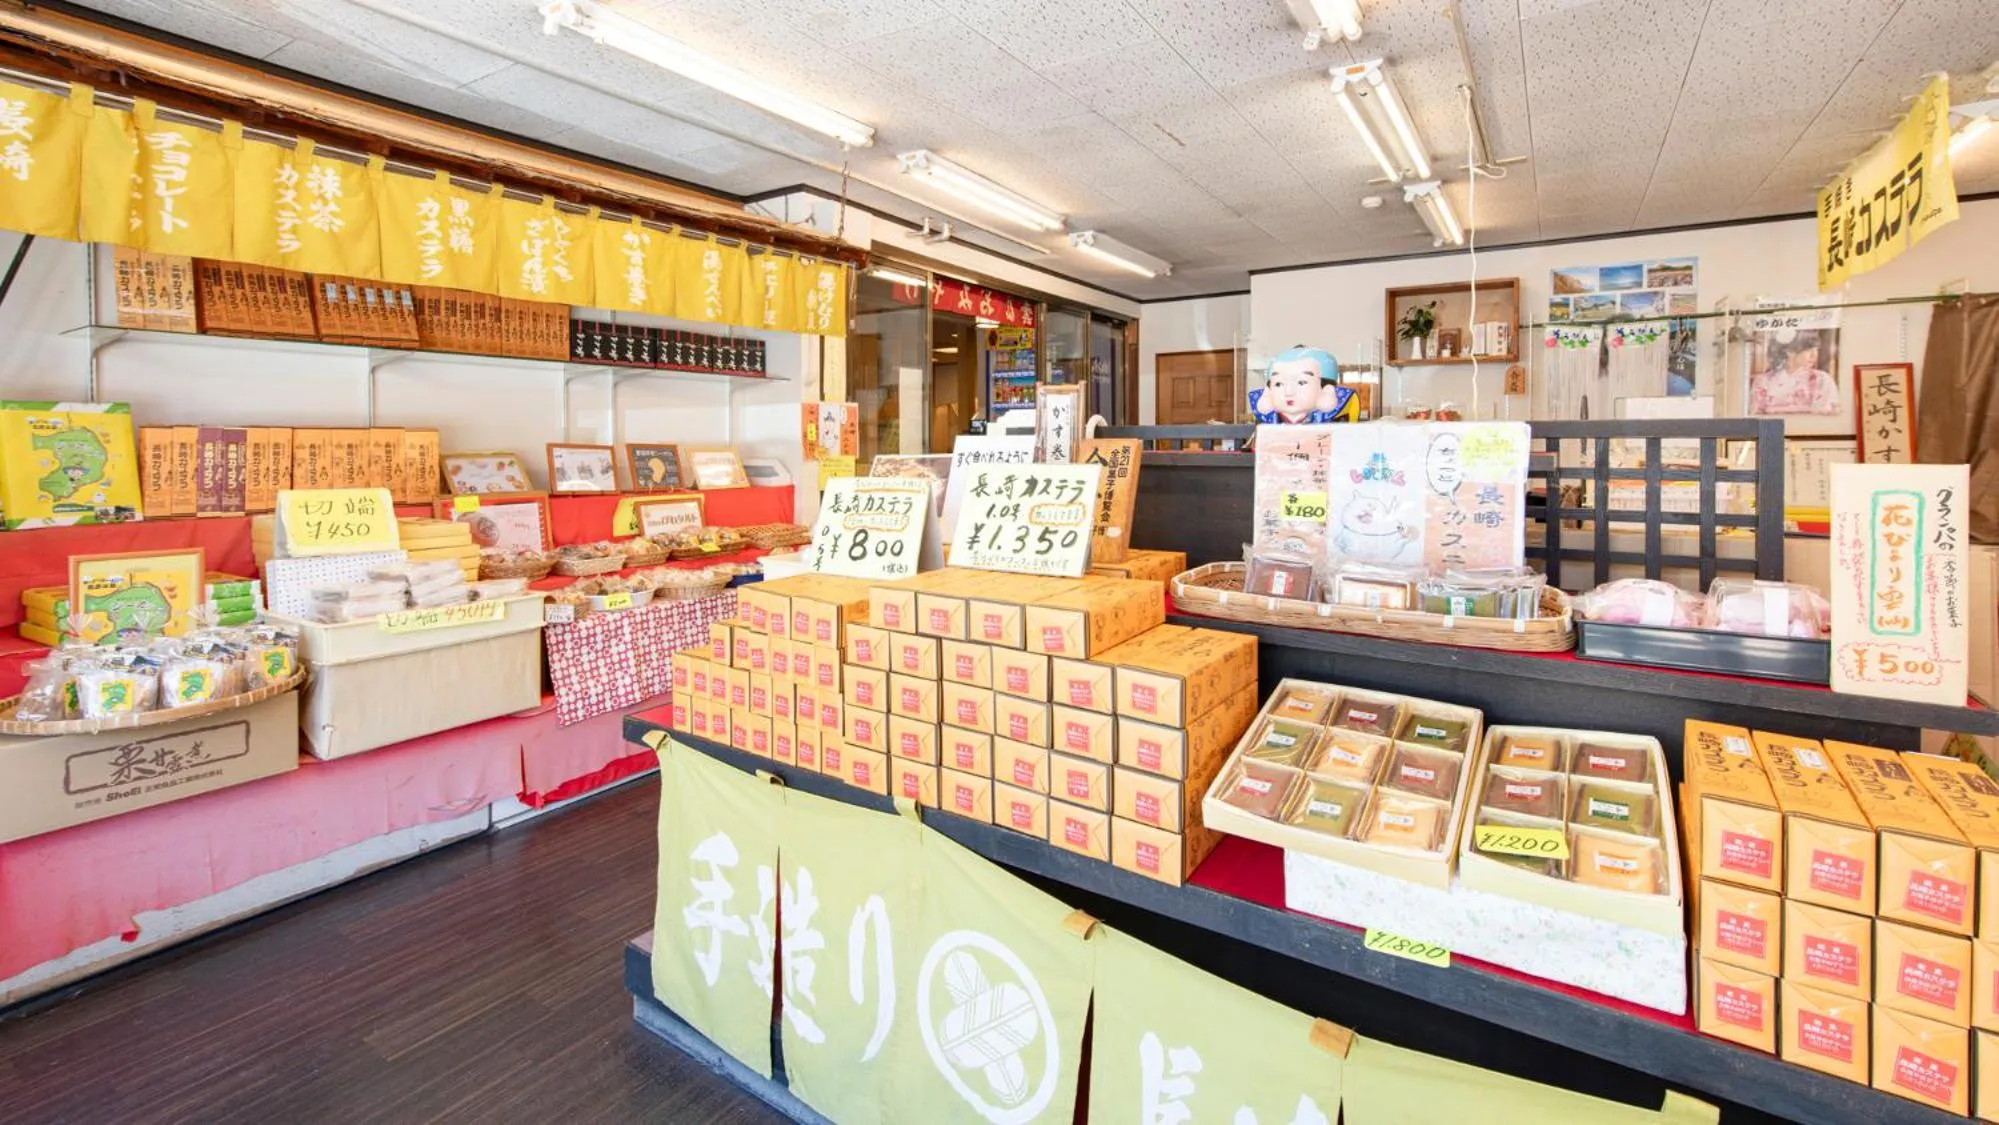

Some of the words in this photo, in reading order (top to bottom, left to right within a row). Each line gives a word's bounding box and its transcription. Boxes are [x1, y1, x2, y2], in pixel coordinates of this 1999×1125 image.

[273, 162, 304, 255] カステラ
[305, 163, 346, 233] 抹茶
[1826, 150, 1924, 273] 長崎カステラ
[415, 195, 445, 279] カステラ
[448, 195, 475, 256] 黒糖
[828, 492, 914, 515] 長崎カステラ
[969, 472, 1087, 504] 長崎カステラ
[1475, 484, 1505, 529] 長崎
[305, 520, 371, 541] ¥450
[1284, 505, 1326, 518] ¥180
[830, 528, 905, 562] ¥800
[1852, 646, 1938, 677] ¥500
[682, 831, 897, 1063] 手造り
